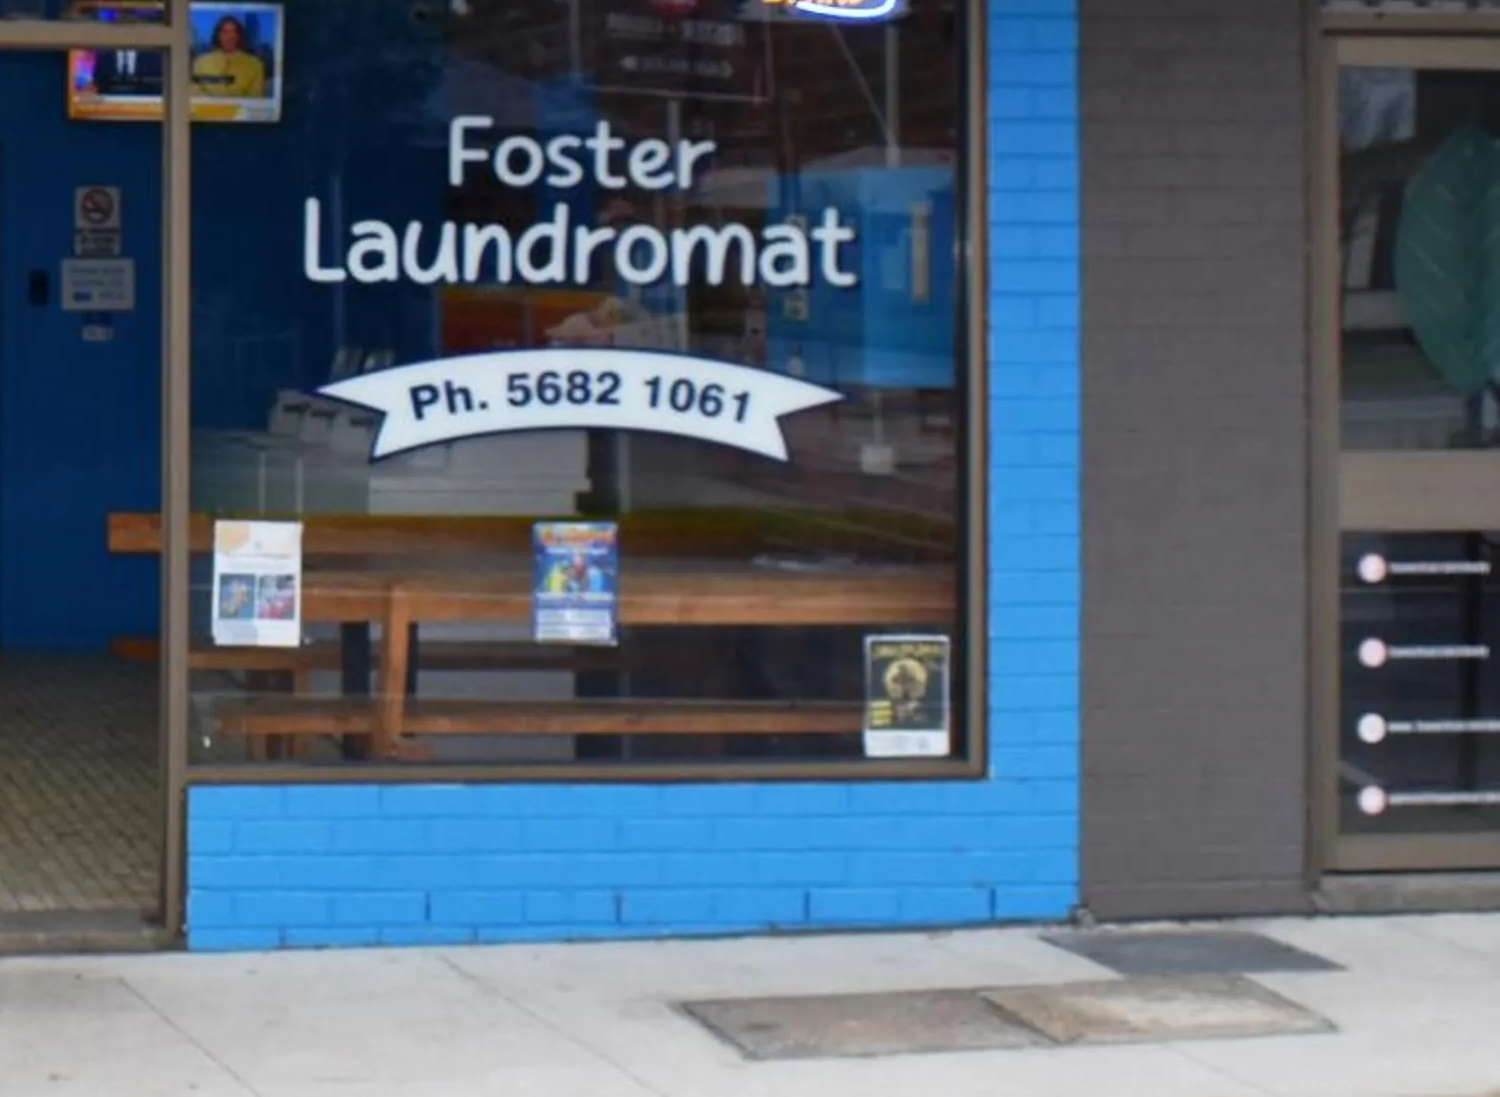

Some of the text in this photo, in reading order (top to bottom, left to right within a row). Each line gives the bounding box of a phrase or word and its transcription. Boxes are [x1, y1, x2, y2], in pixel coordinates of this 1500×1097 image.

[449, 116, 716, 188] Foster
[304, 198, 856, 287] Laundromat
[409, 369, 751, 423] Ph. 5682 1061
